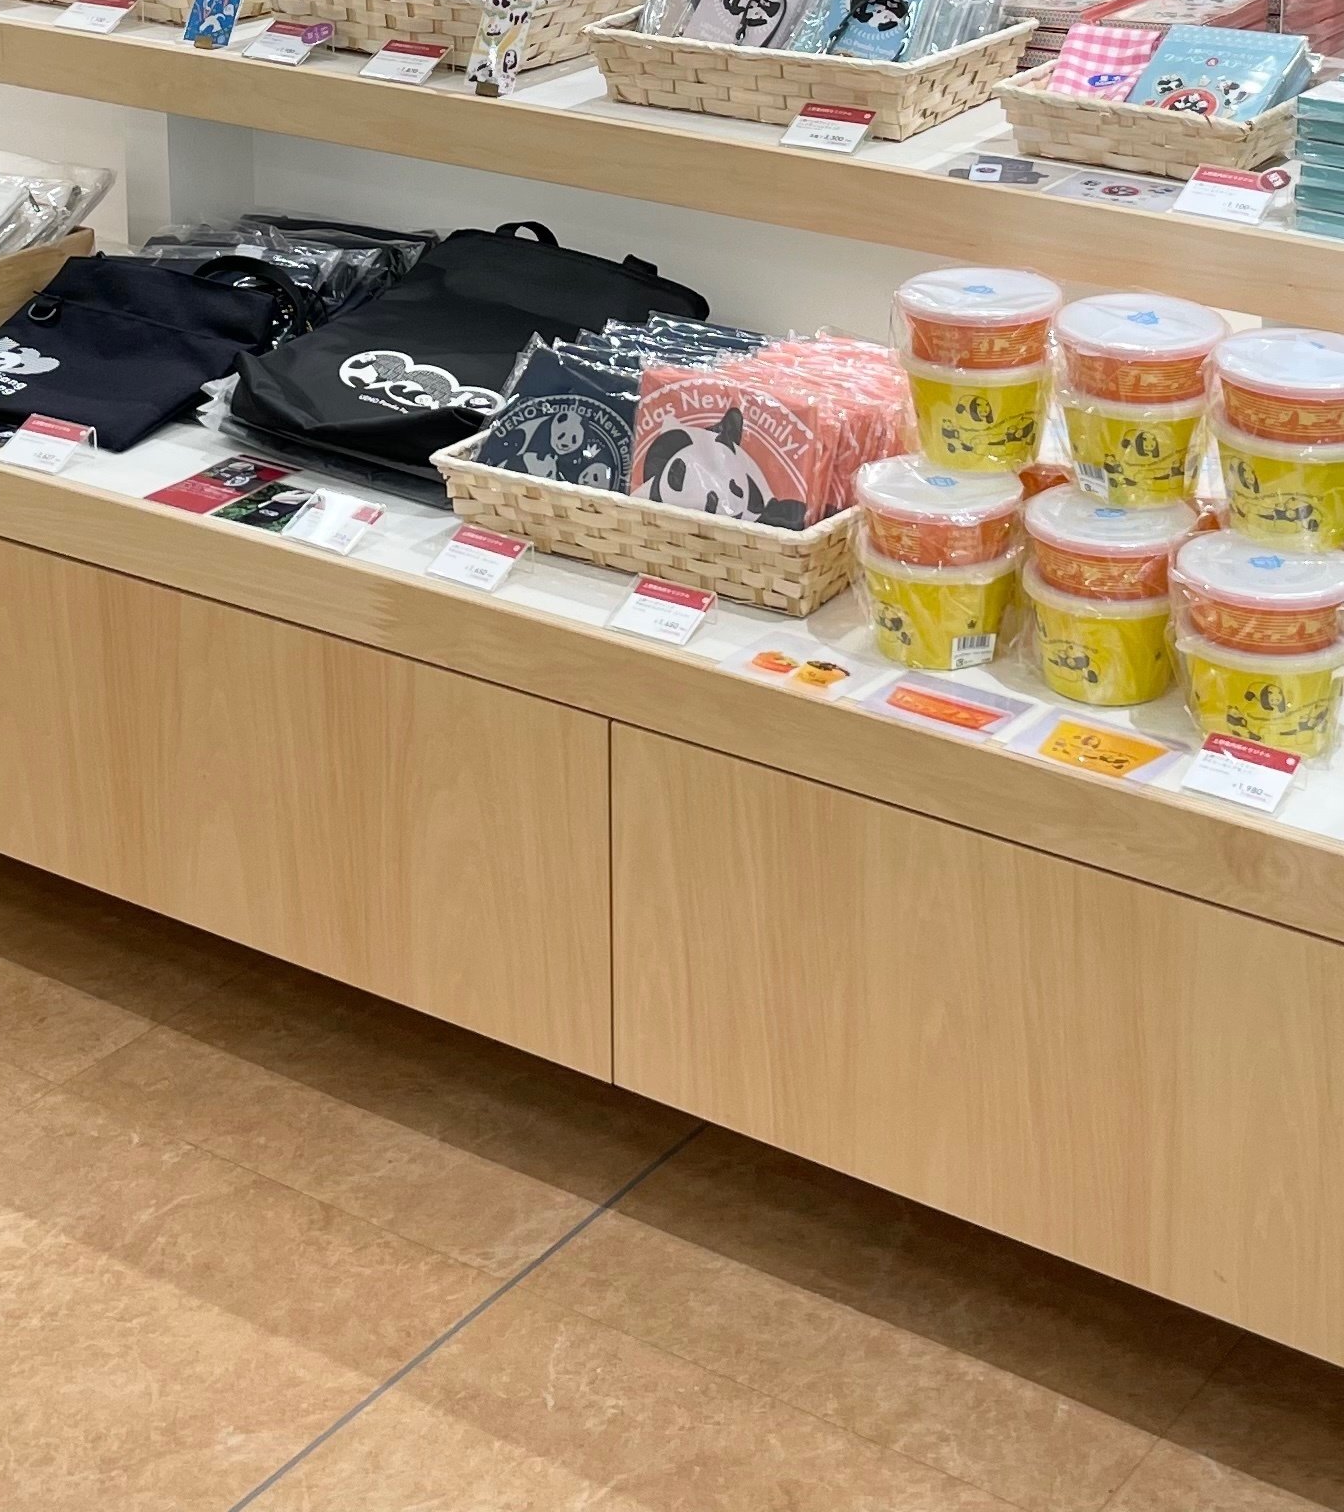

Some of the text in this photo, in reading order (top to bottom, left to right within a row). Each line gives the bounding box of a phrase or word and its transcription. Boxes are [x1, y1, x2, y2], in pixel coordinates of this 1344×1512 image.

[494, 405, 538, 438] UENO
[681, 389, 734, 412] New
[737, 390, 809, 460] Family!
